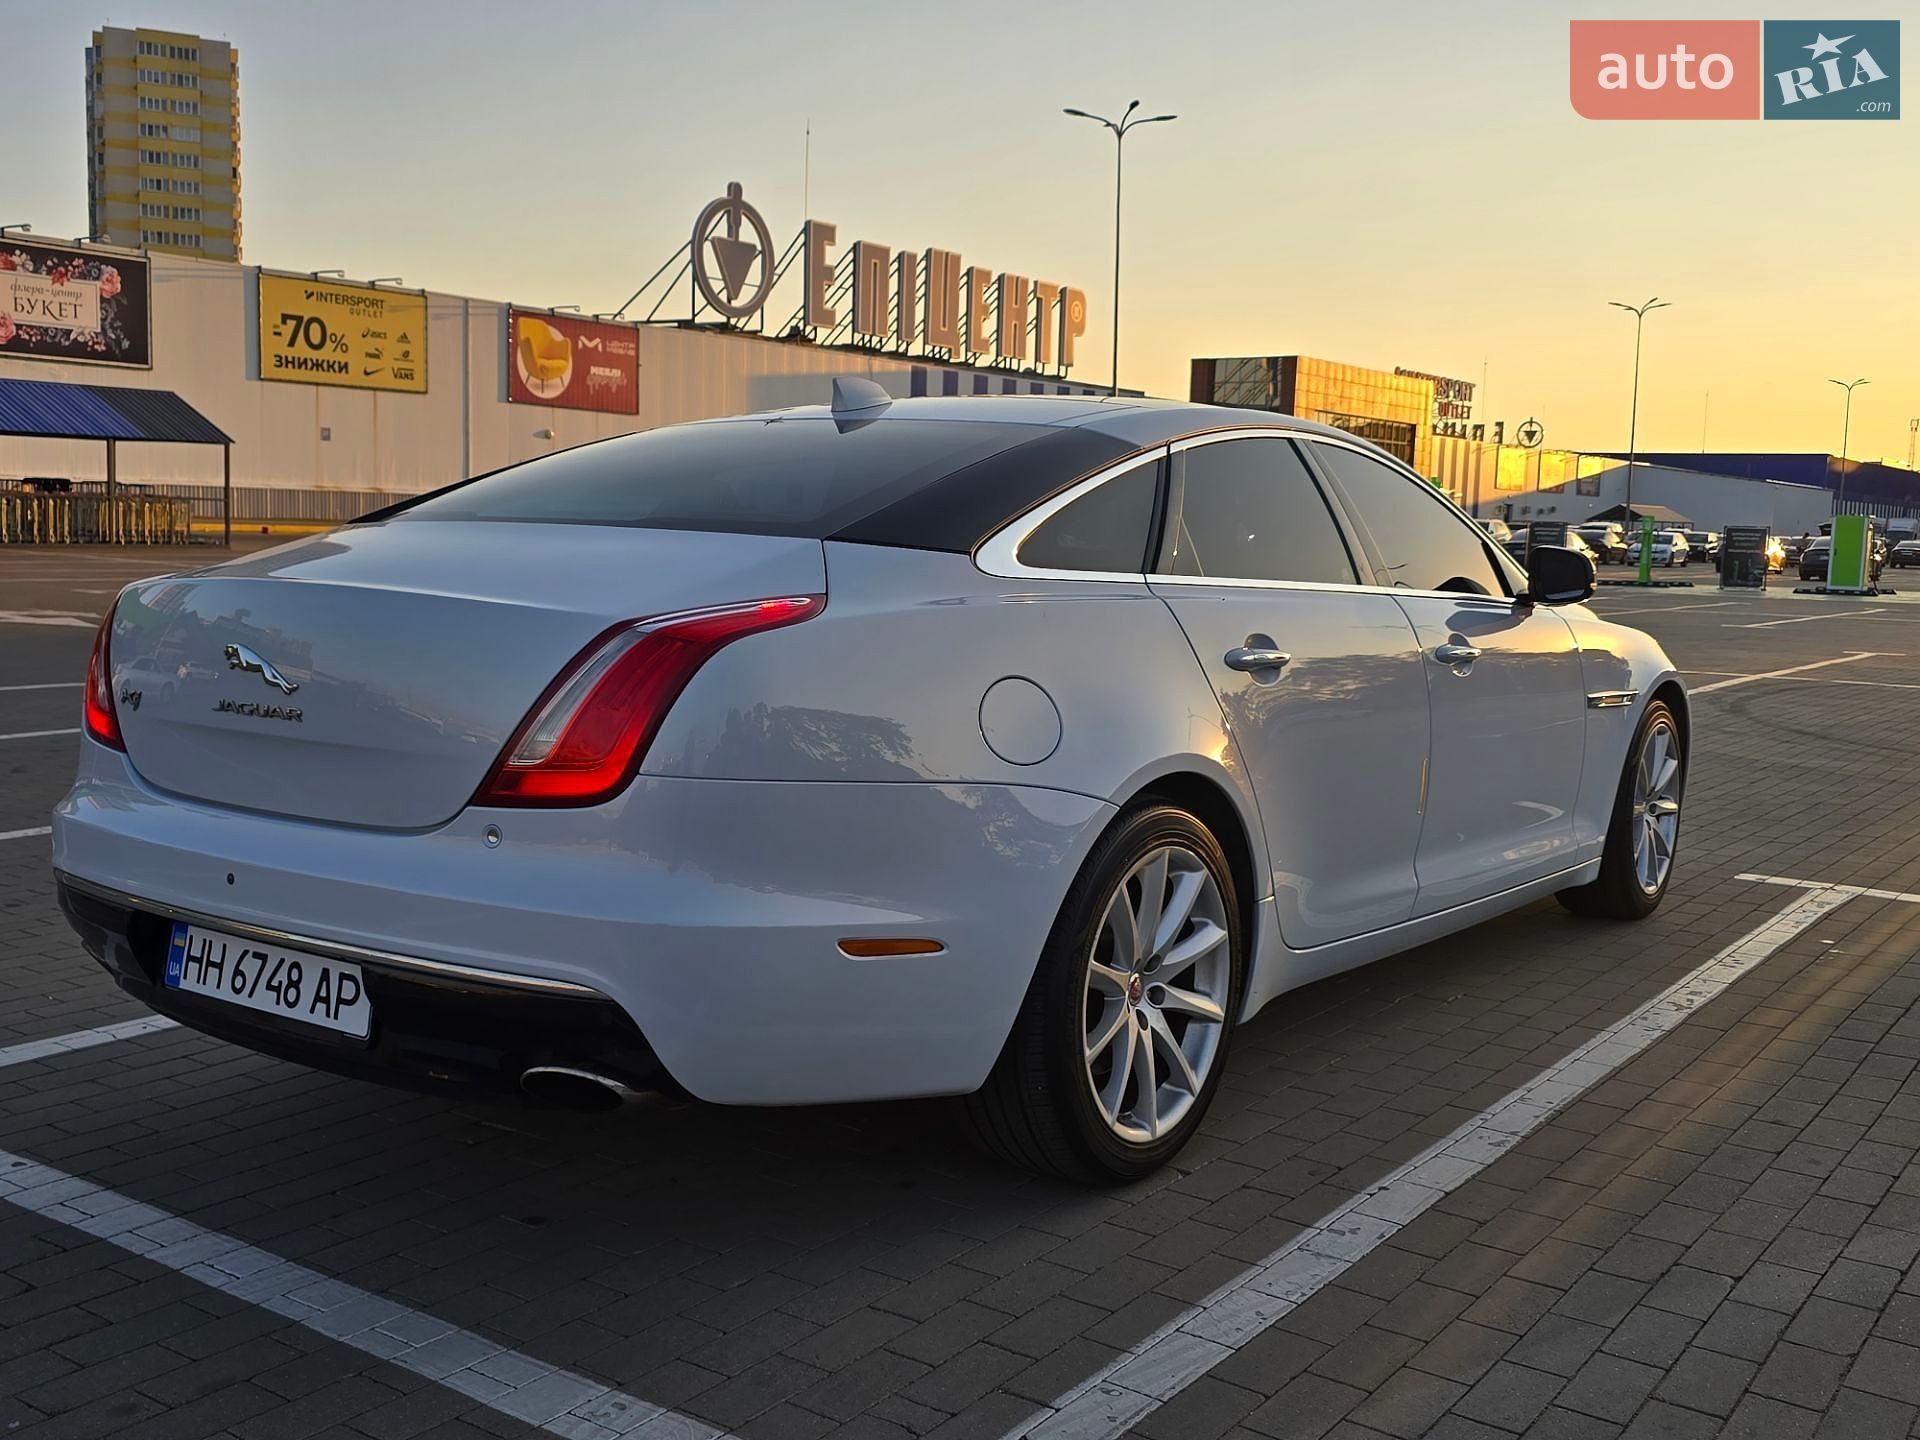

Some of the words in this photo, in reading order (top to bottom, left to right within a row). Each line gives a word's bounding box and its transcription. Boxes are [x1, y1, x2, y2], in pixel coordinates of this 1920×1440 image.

[316, 290, 385, 309] INTERSPORT
[804, 218, 1088, 368] ЕПІЦЕНТР
[14, 296, 83, 321] БУКЕТ
[349, 307, 384, 319] OUTLET
[272, 312, 349, 354] -70%
[273, 354, 349, 375] ЗНИЖКИ
[212, 699, 304, 724] JAGUAR
[168, 961, 181, 977] UA
[231, 948, 304, 1010] 6748
[308, 966, 361, 1021] AP
